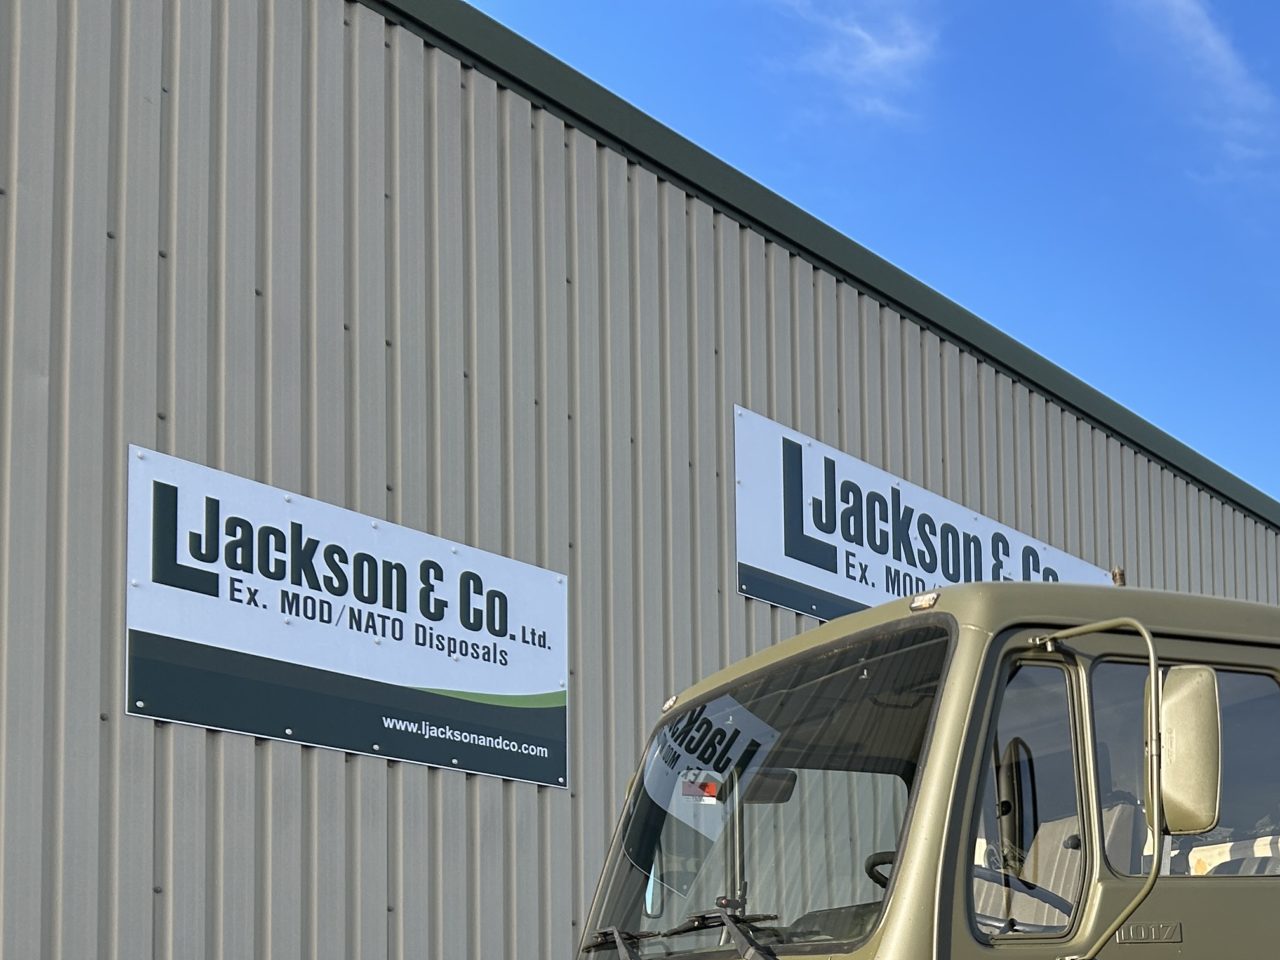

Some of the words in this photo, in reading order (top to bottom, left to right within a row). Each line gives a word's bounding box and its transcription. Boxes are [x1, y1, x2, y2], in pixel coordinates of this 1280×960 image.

[845, 551, 876, 588] Ex.
[229, 577, 267, 609] Ex.
[280, 589, 404, 641] MOD/NATO
[415, 623, 508, 666] Disposals
[419, 559, 448, 622] &
[459, 570, 516, 641] Co.
[521, 625, 552, 650] Ltd.
[382, 716, 548, 758] www.ljacksonandco.com
